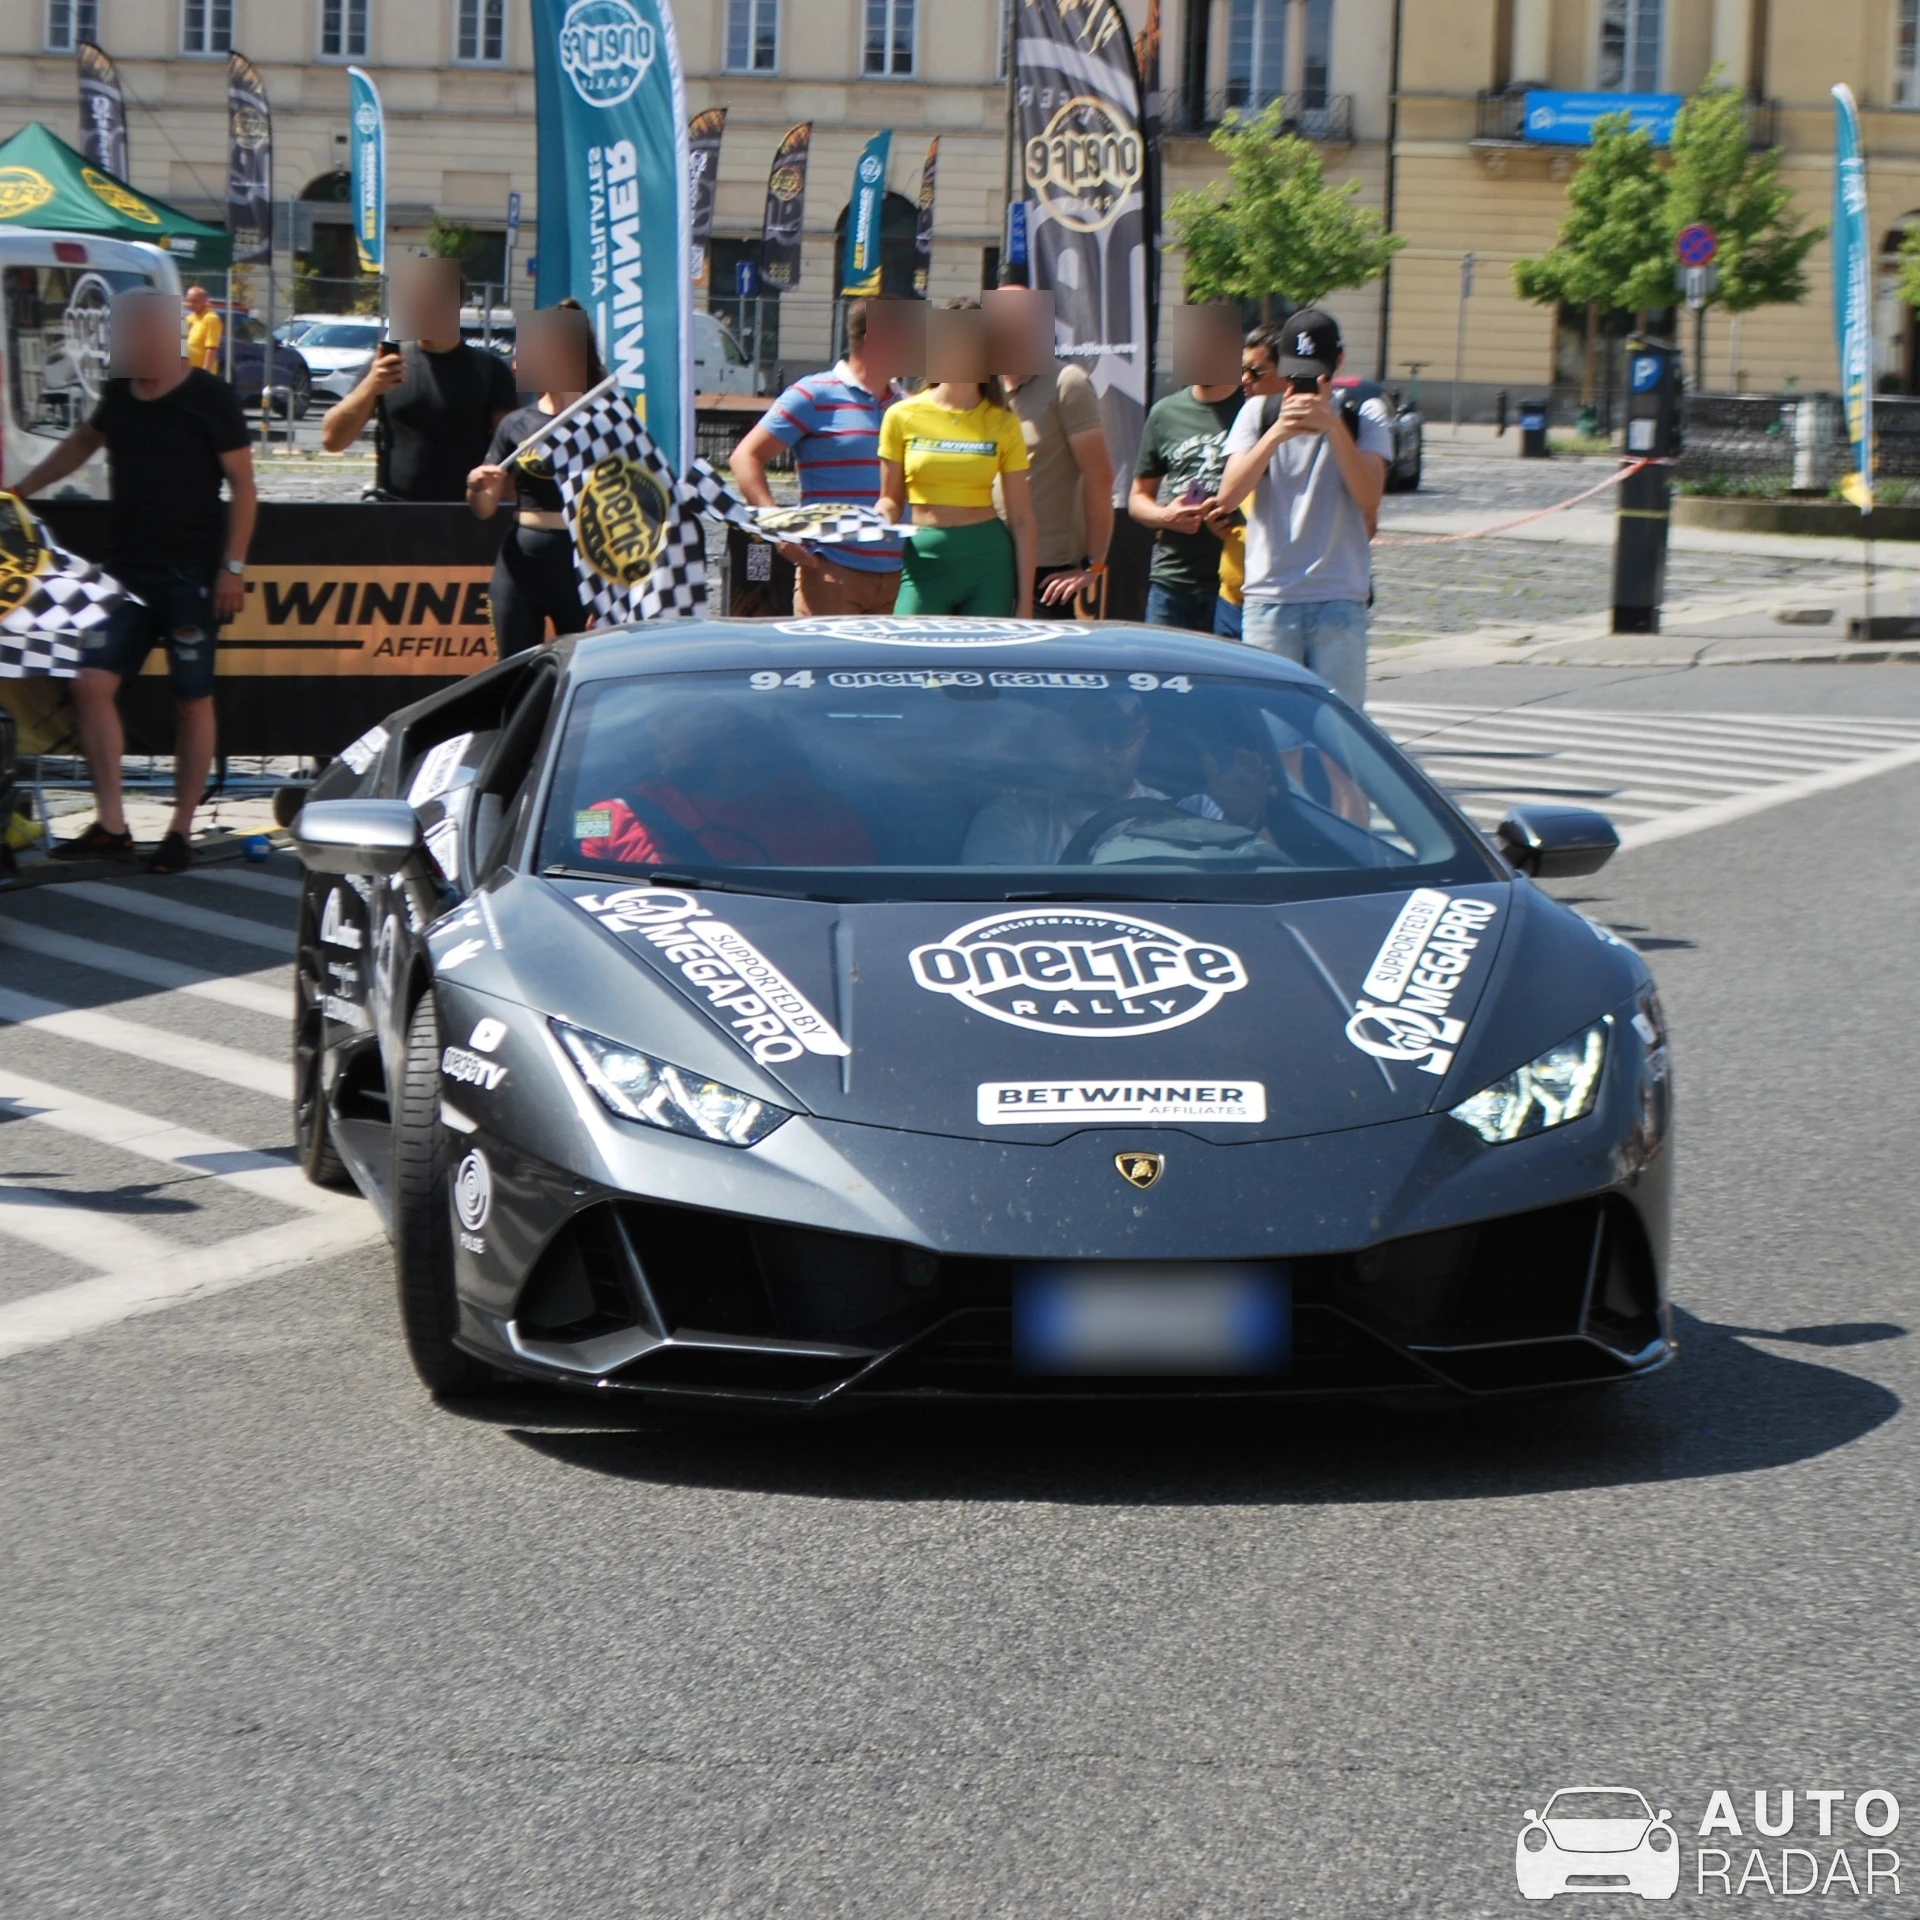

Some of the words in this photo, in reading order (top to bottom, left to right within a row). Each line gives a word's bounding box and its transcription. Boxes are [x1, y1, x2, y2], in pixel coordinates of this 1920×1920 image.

[1633, 357, 1659, 388] P
[750, 670, 815, 690] 94
[1127, 673, 1193, 693] 94
[1375, 914, 1430, 984] SUPPORTED
[1416, 900, 1437, 918] BY
[1399, 898, 1497, 1016] MEGAPRO
[638, 921, 804, 1064] MEGAPRO
[710, 933, 804, 1012] SUPPORTED
[792, 1012, 828, 1037] BY
[1011, 999, 1177, 1015] RALLY
[1149, 1105, 1247, 1116] AFFILIATES
[460, 1232, 486, 1254] PULSE
